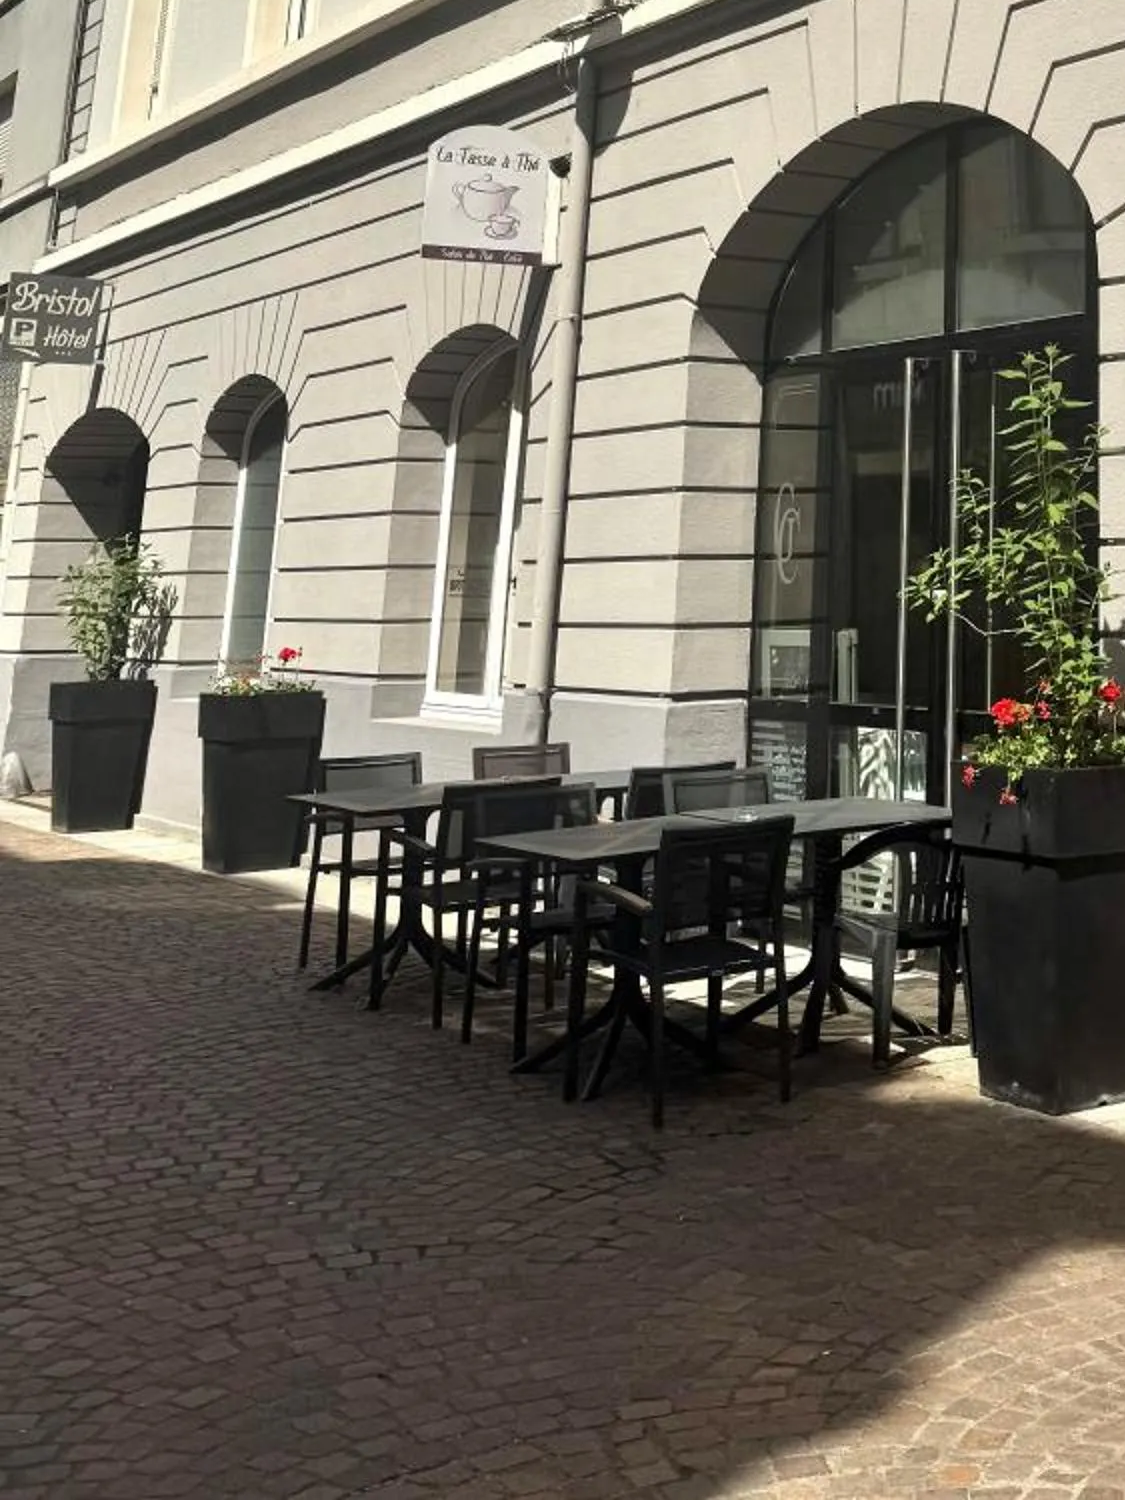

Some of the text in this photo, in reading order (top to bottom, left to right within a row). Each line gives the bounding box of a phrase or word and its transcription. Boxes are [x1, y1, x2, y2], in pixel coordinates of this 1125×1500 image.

[437, 145, 453, 162] La
[460, 145, 497, 166] Tasse
[11, 281, 100, 317] Bristol
[43, 324, 93, 349] Hôtel
